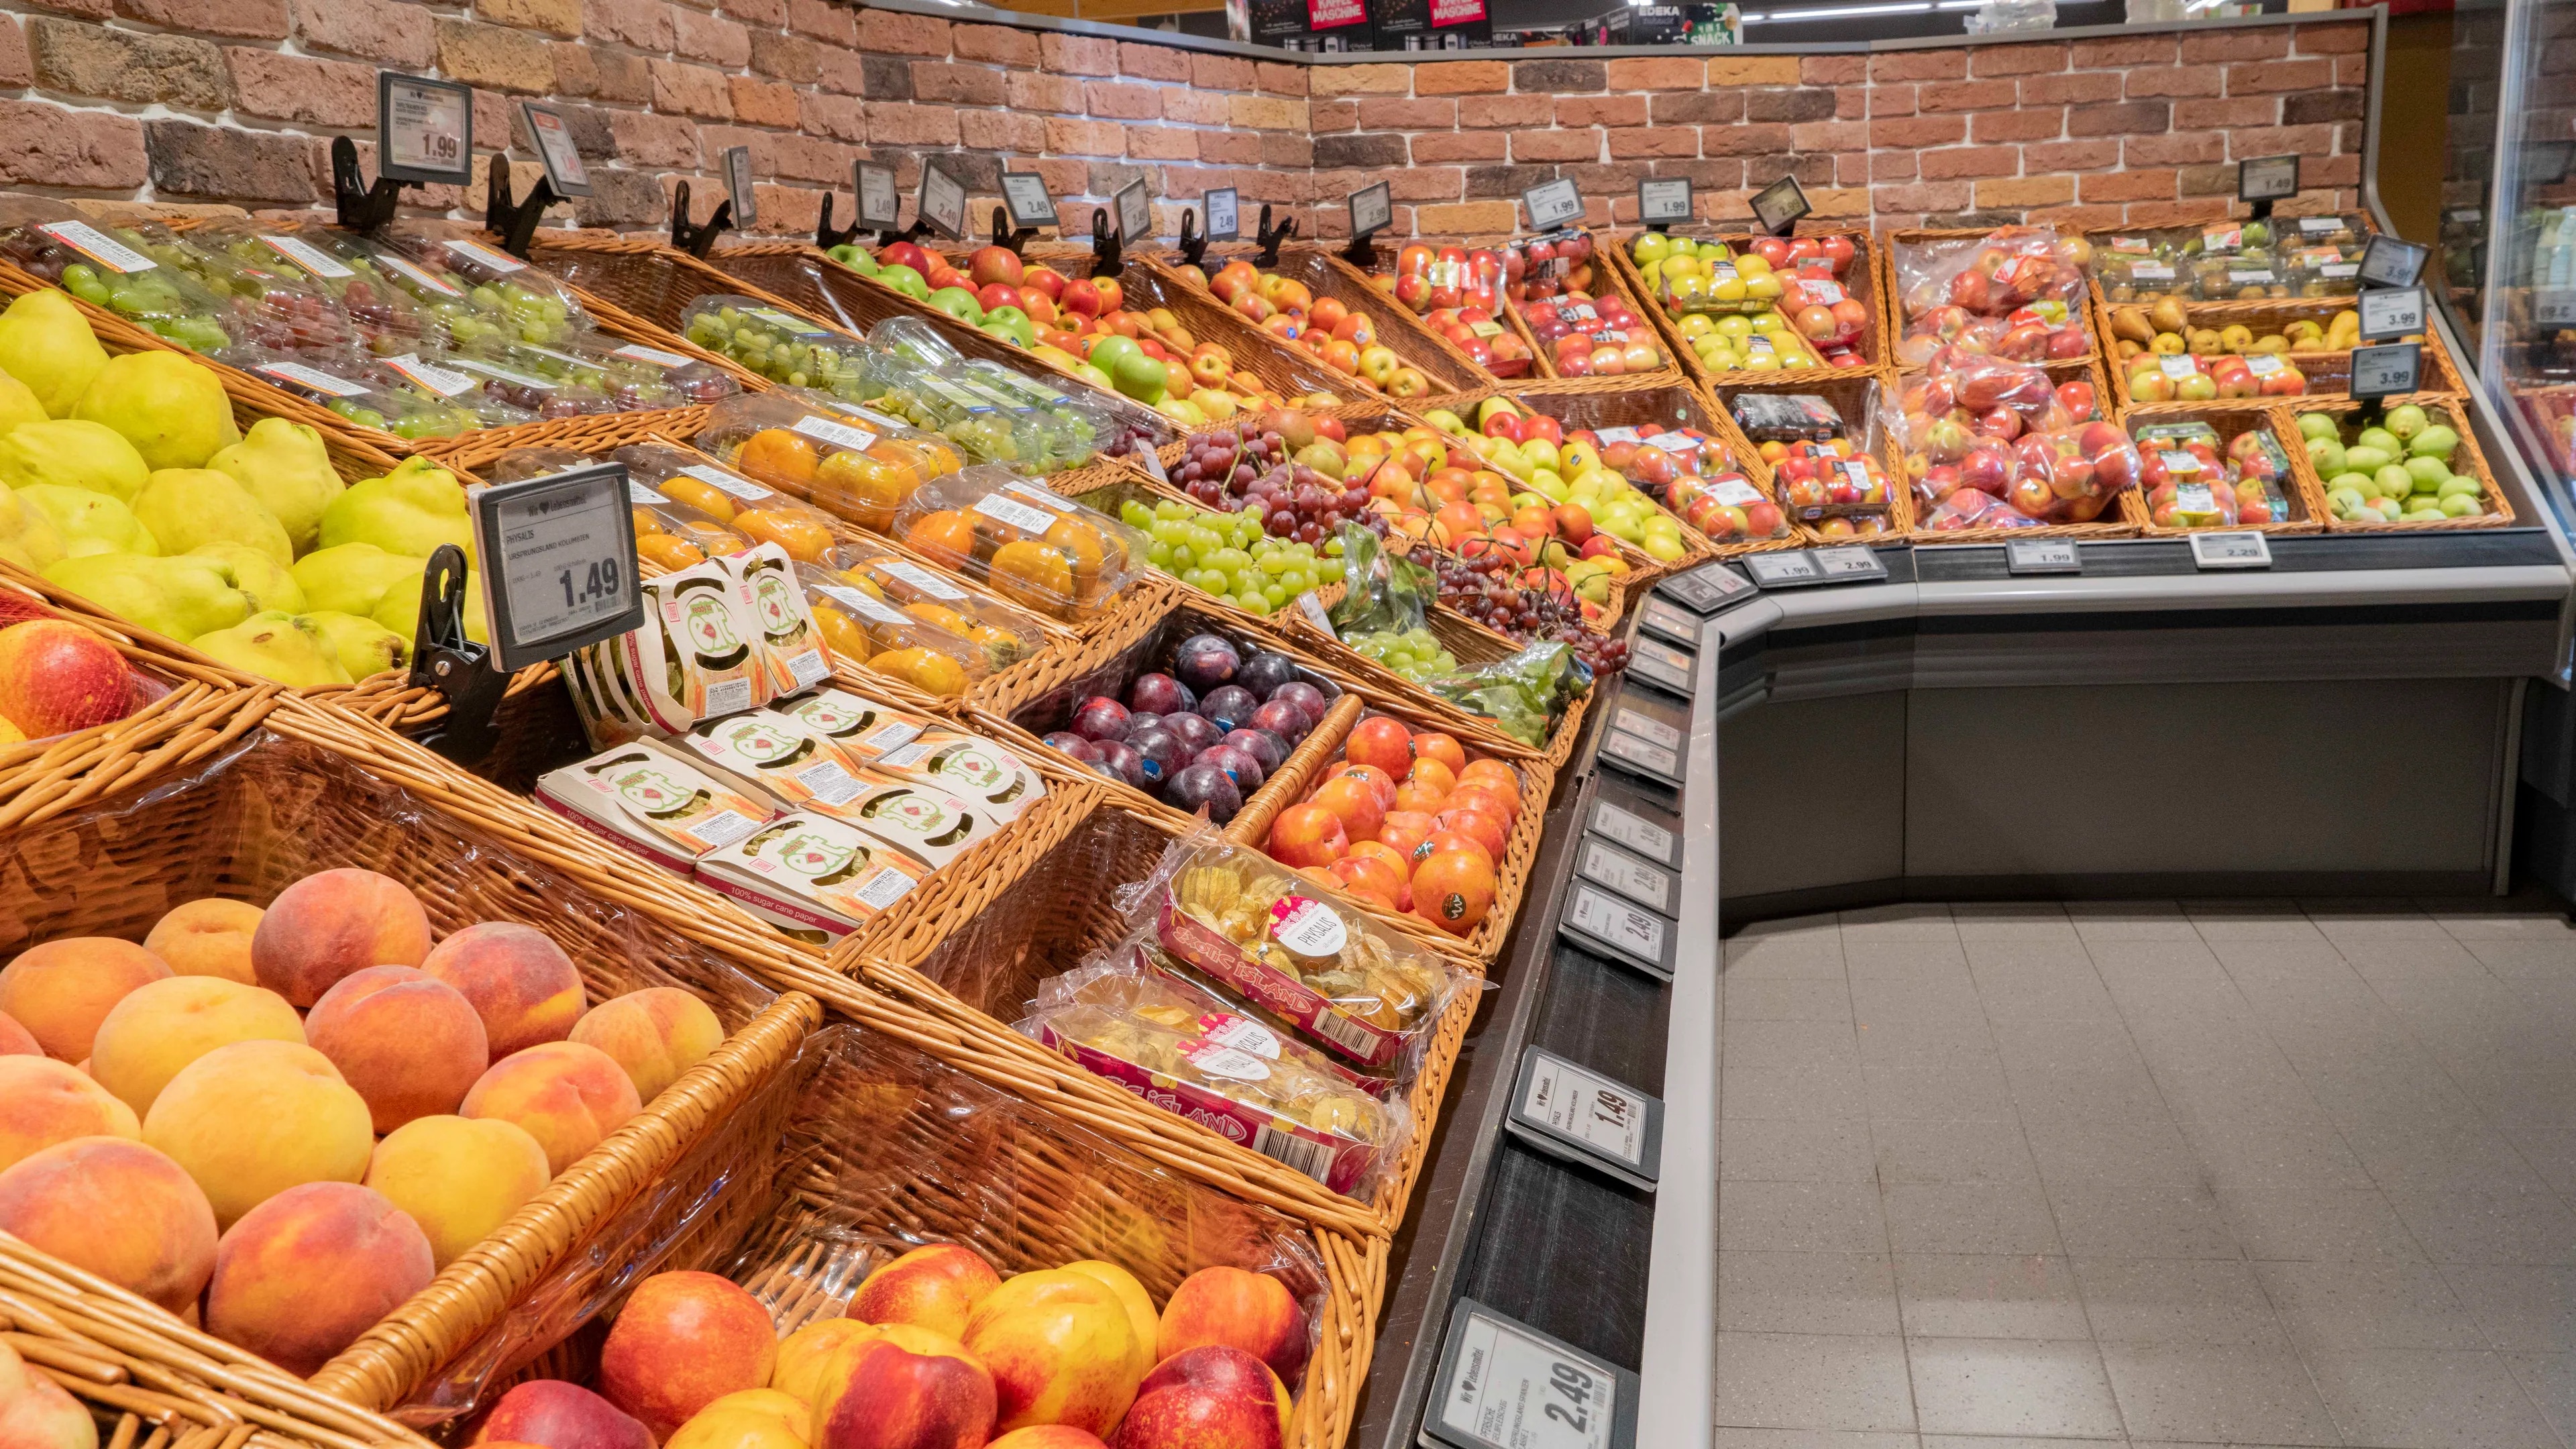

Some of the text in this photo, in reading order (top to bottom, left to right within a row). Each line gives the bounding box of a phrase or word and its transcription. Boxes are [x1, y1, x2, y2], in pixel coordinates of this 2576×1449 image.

[1312, 4, 1362, 23] MASCHINE
[1638, 6, 1680, 16] EDEKA
[1493, 32, 1517, 42] EKA
[1690, 32, 1731, 46] SNACK
[423, 133, 457, 159] 1.99
[875, 198, 892, 215] 2.49
[939, 203, 957, 223] 2.49
[1028, 201, 1049, 213] 2.49
[1552, 200, 1574, 214] 1.99
[1663, 201, 1686, 212] 1.99
[1220, 215, 1233, 227] 2.49
[2389, 313, 2416, 325] 3.99
[2380, 371, 2409, 384] 3.99
[506, 530, 535, 545] PHYSALIS
[508, 533, 590, 560] URSPRUNGSLAND KOLUMBIEN
[2227, 549, 2258, 557] 2.29
[1845, 561, 1872, 570] 2.99
[2041, 554, 2070, 562] 1.99
[1782, 566, 1811, 576] 1.99
[559, 557, 619, 608] 1.49
[692, 605, 706, 614] ready
[626, 630, 653, 709] 00% sugar cane paper
[566, 810, 649, 857] 100% sugar cane paper
[782, 844, 797, 855] ready
[731, 886, 817, 924] 100% sugar cane paper
[1297, 916, 1337, 947] PHYSALIS
[1625, 912, 1652, 942] 2.49
[1234, 1032, 1268, 1051] YSALIS
[1595, 1089, 1627, 1128] 1.49
[1460, 1346, 1485, 1405] Wir Lebensmittel
[1518, 1378, 1530, 1403] SPANIEN
[1544, 1362, 1593, 1434] 2.49
[1480, 1406, 1496, 1438] PFIRSICHE
